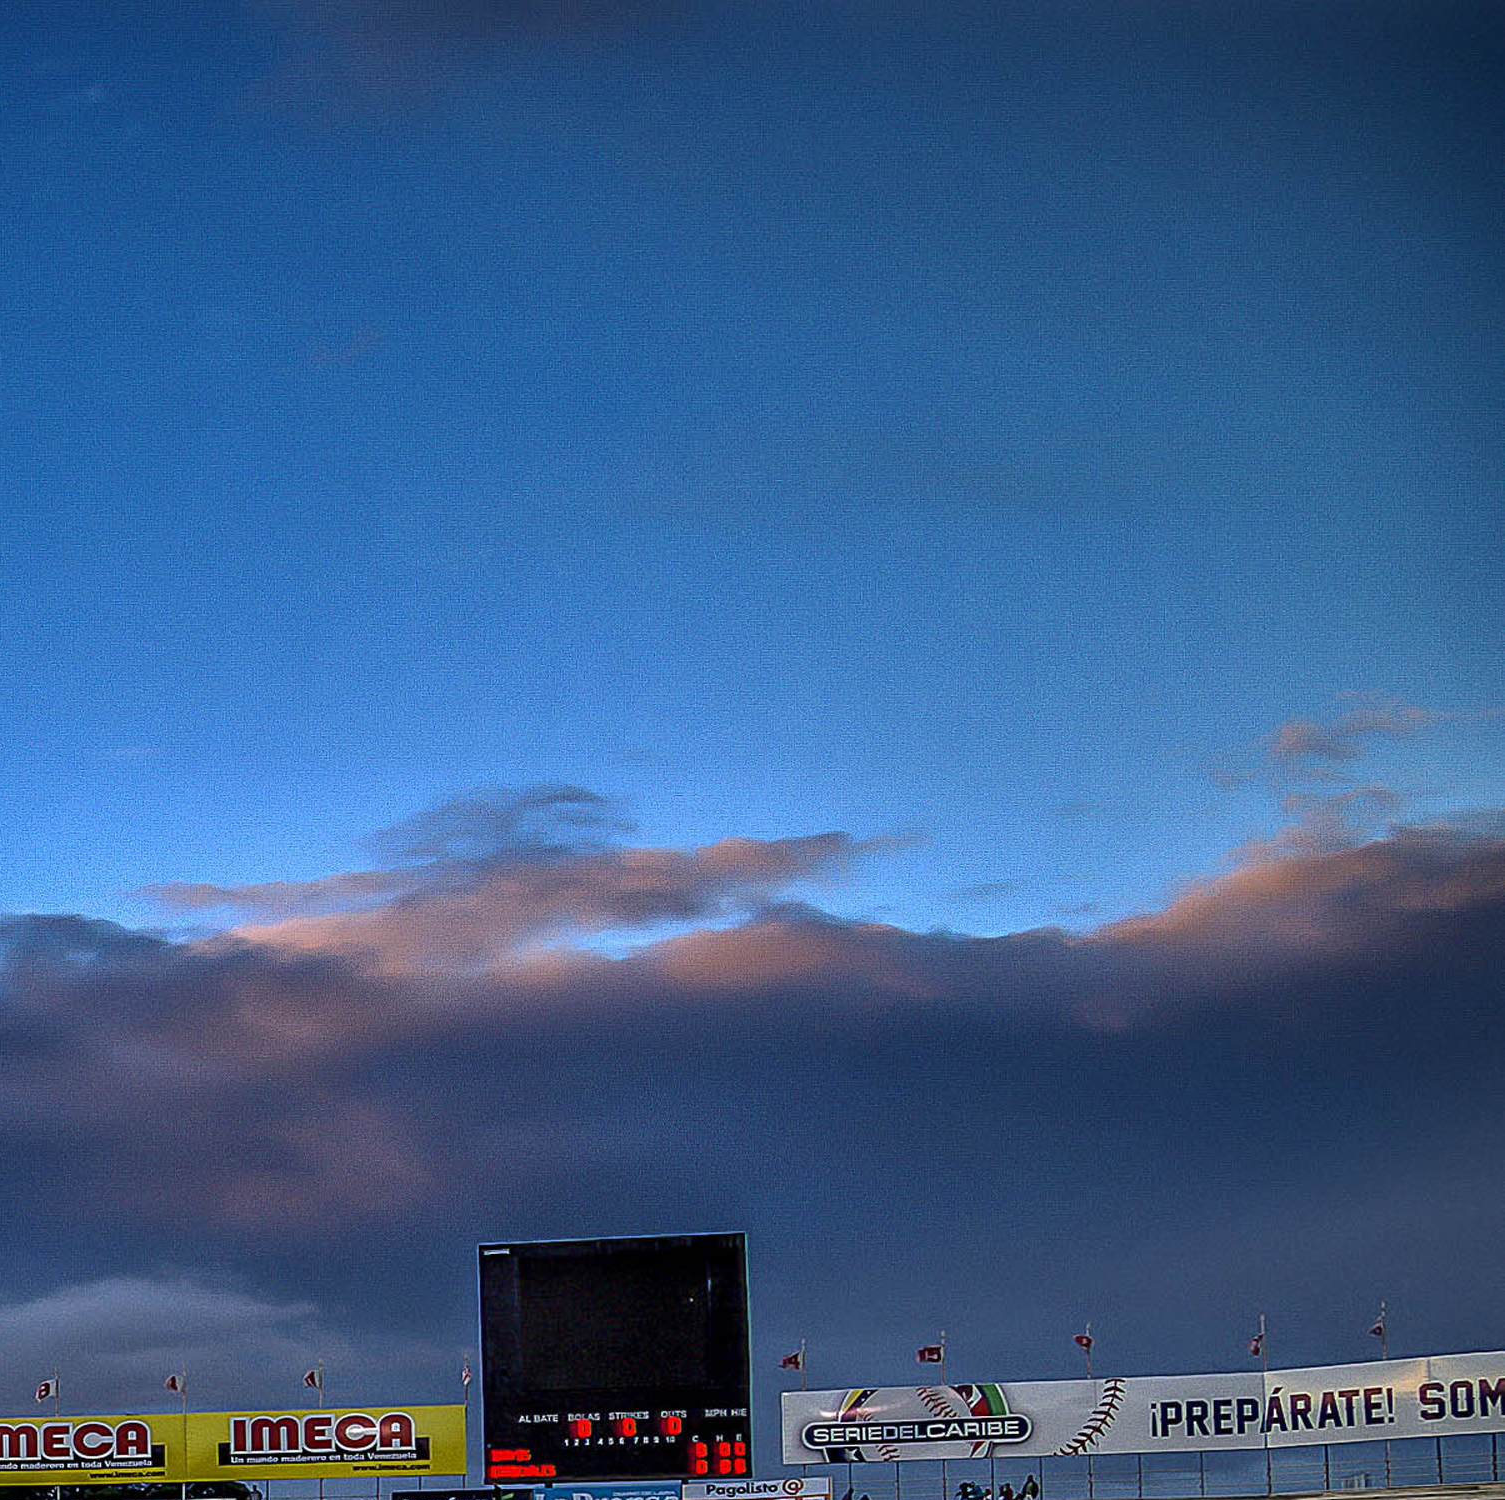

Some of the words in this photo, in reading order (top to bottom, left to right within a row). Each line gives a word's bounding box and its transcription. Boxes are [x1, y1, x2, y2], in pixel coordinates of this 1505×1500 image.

[519, 1415, 532, 1423] AL
[534, 1414, 558, 1422] BATE
[568, 1413, 600, 1421] BOLAS
[608, 1411, 649, 1420] STRIKES
[660, 1410, 687, 1418] OUTS
[1150, 1386, 1395, 1438] ¡PREPÁRATE!
[230, 1412, 416, 1454] IMECA
[813, 1420, 1020, 1442] SERIEDELCARIBE
[20, 1461, 64, 1469] maderero
[81, 1460, 102, 1468] toda
[105, 1459, 153, 1468] Venezuela
[281, 1454, 326, 1462] maderero
[343, 1453, 365, 1461] toda
[367, 1452, 417, 1460] Venezuela
[352, 1463, 431, 1471] www.imeca.com
[706, 1482, 778, 1498] Pagolisto
